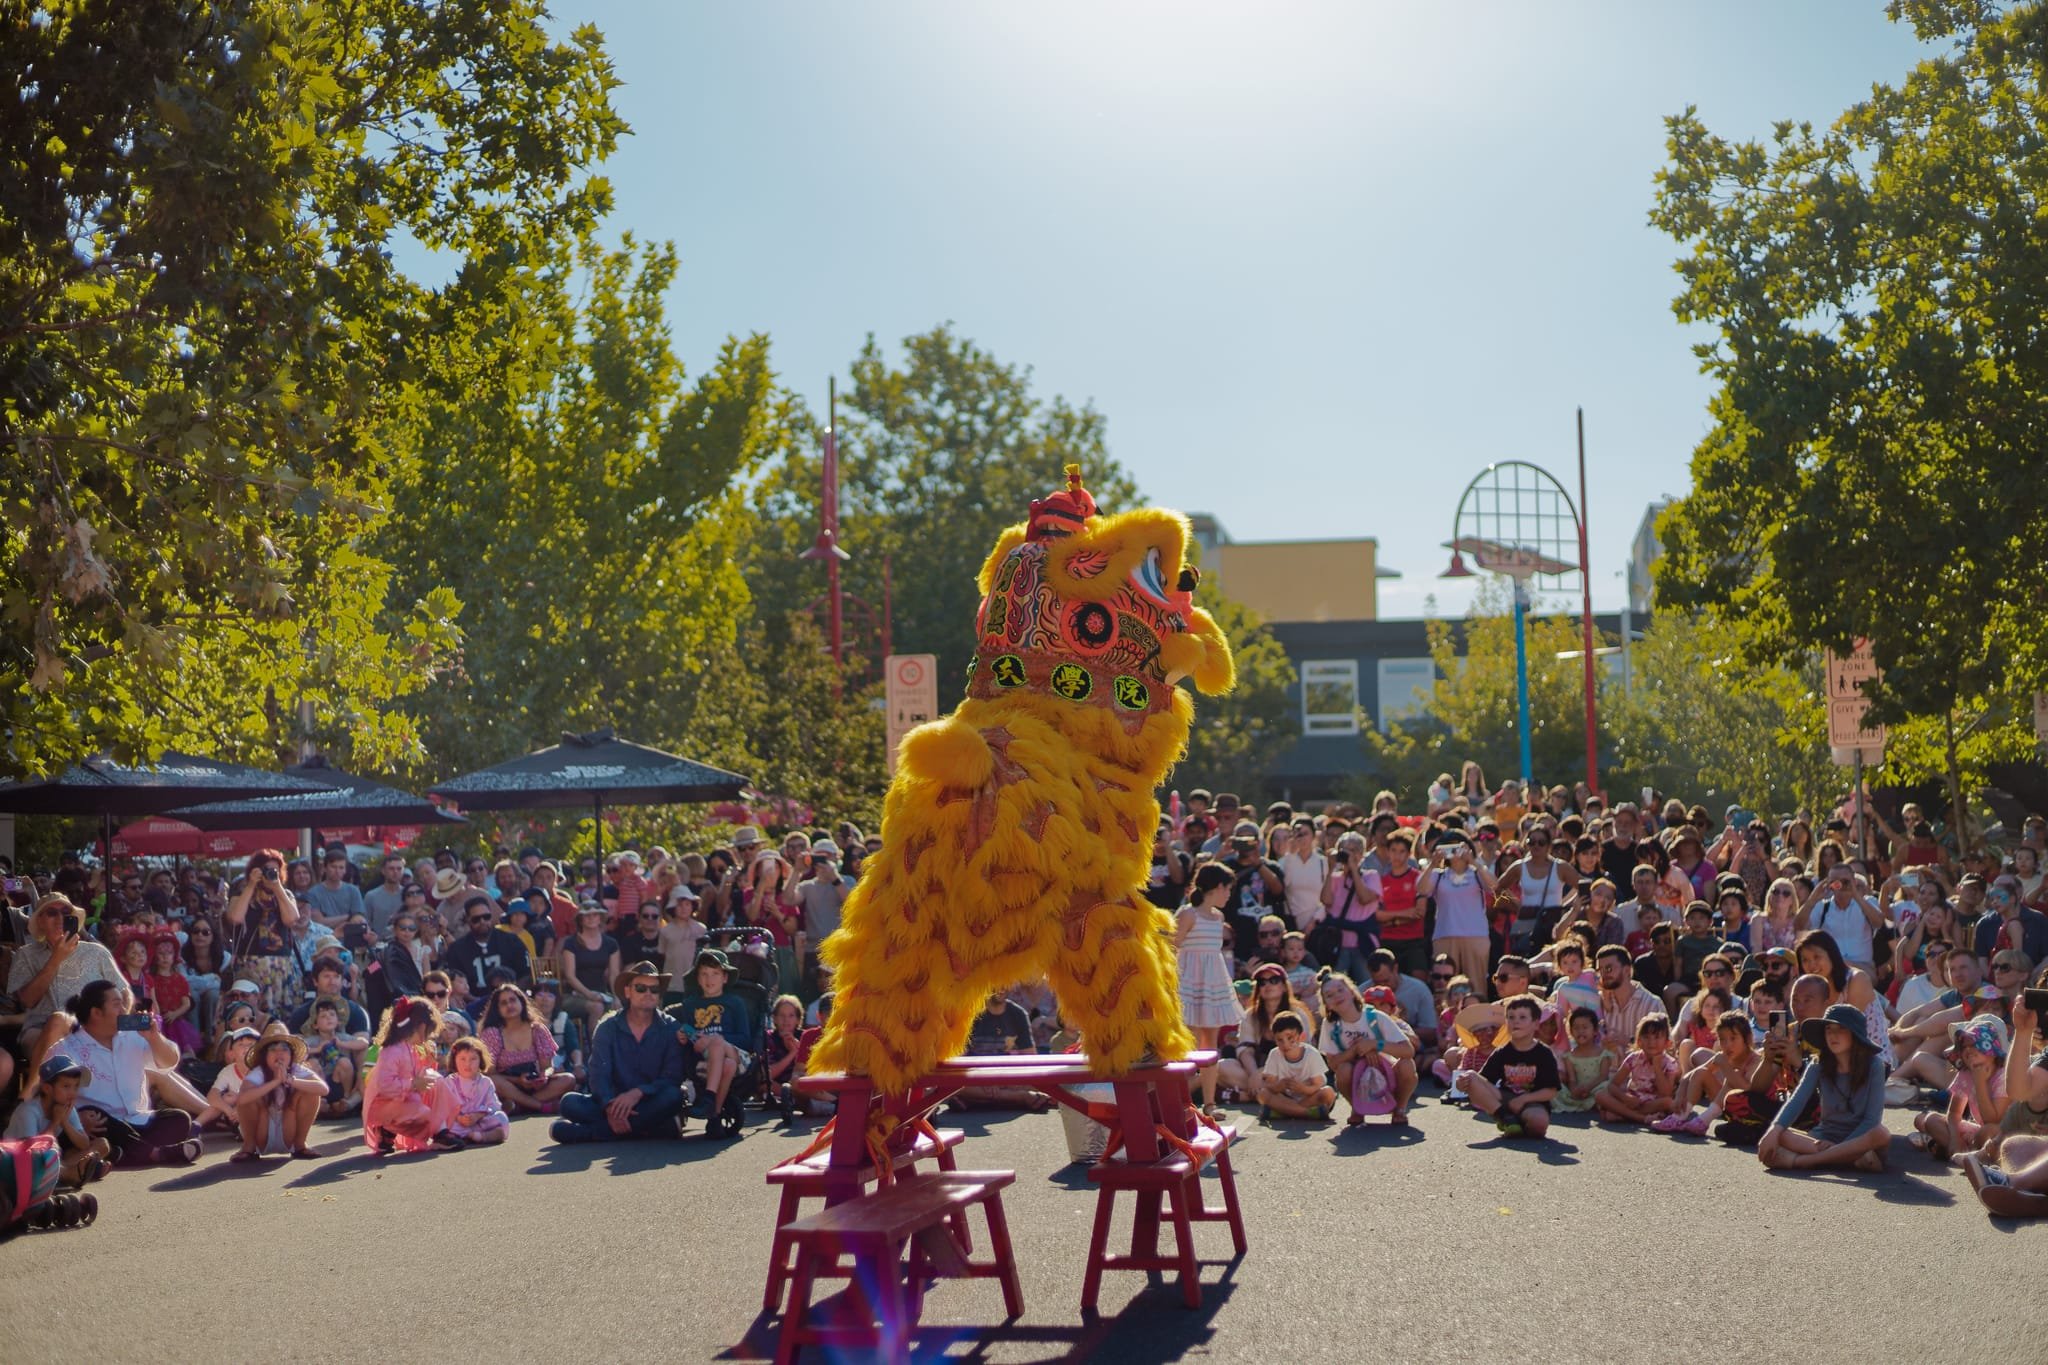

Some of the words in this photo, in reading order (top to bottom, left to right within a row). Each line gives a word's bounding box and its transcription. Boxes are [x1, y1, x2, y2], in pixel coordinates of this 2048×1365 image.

[1841, 662, 1865, 672] ZONE
[1836, 704, 1854, 713] GIVE
[472, 955, 501, 988] 17
